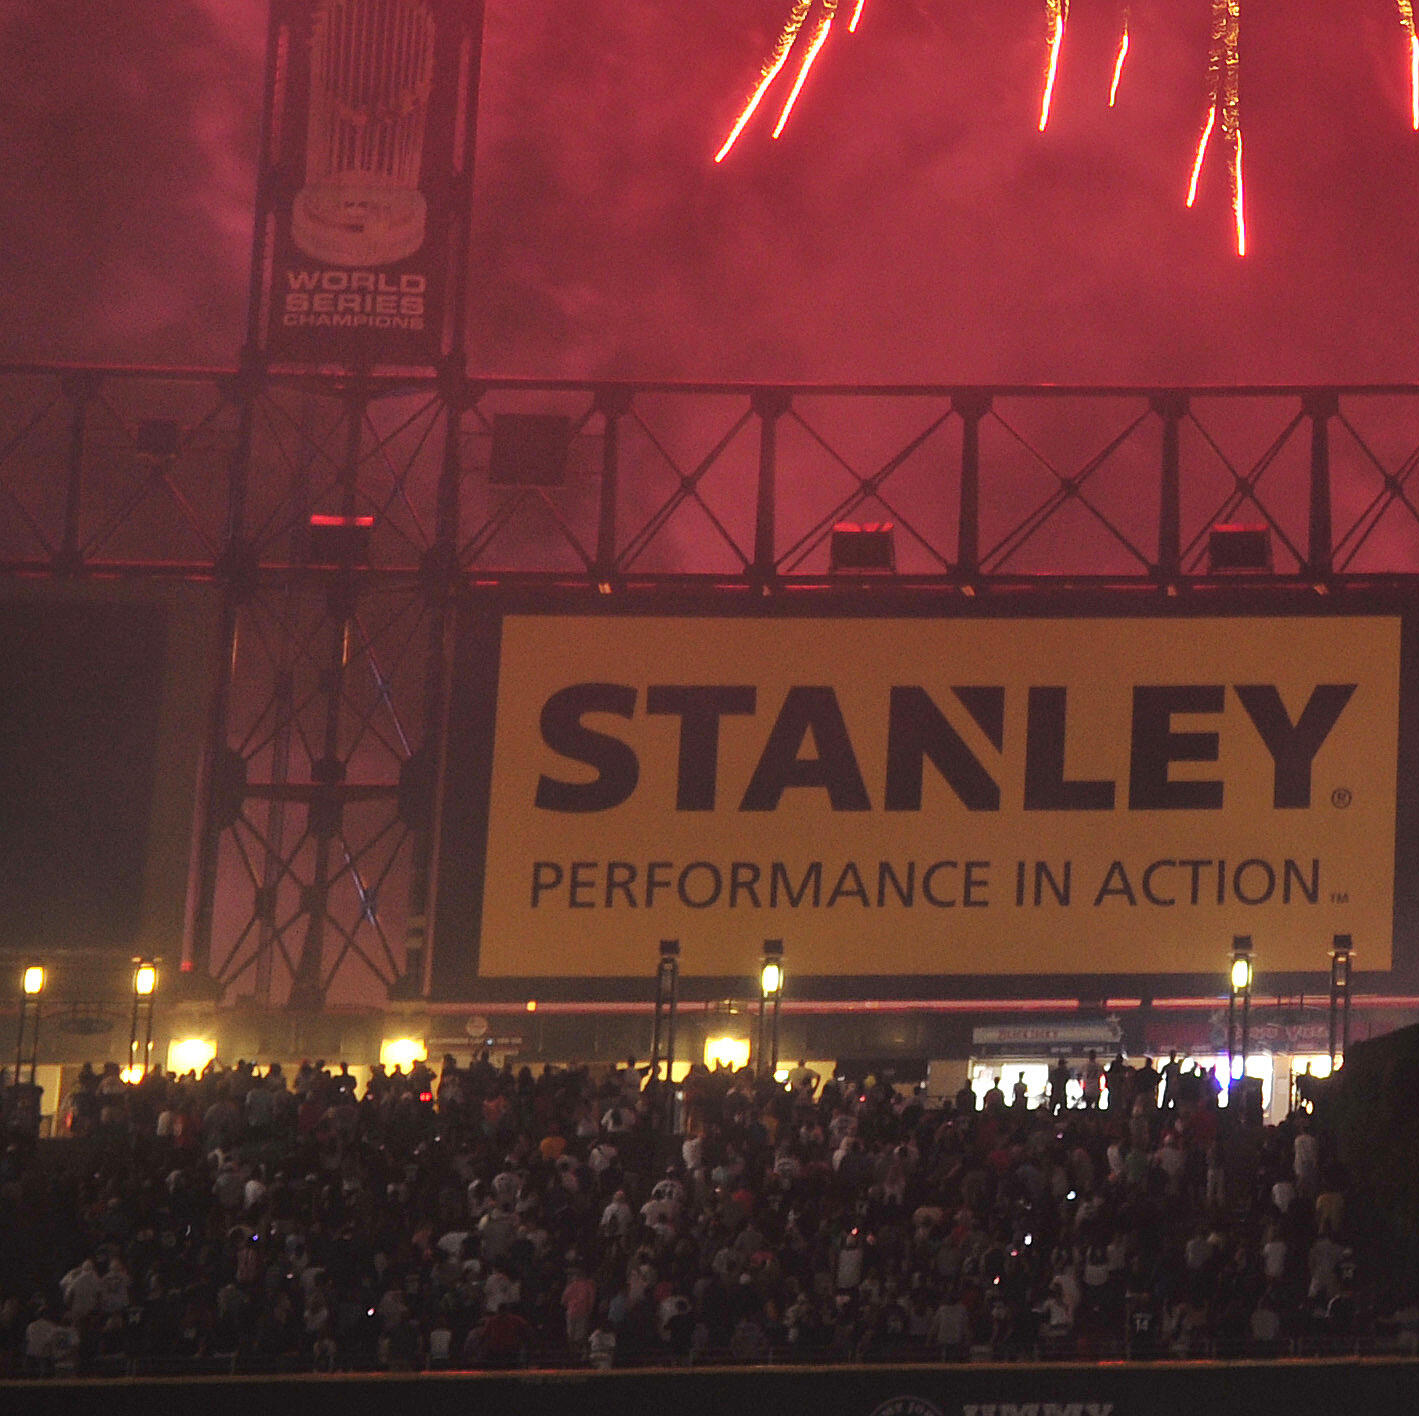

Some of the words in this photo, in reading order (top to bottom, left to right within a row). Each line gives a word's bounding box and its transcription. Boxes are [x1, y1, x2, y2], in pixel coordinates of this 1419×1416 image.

[287, 271, 427, 292] WORLD
[284, 292, 424, 314] SERIES
[283, 314, 423, 330] CHAMPIONS
[533, 682, 1358, 814] STANLEY
[531, 860, 990, 908] PERFORMANCE
[1015, 860, 1071, 907] IN
[1094, 858, 1321, 906] ACTION
